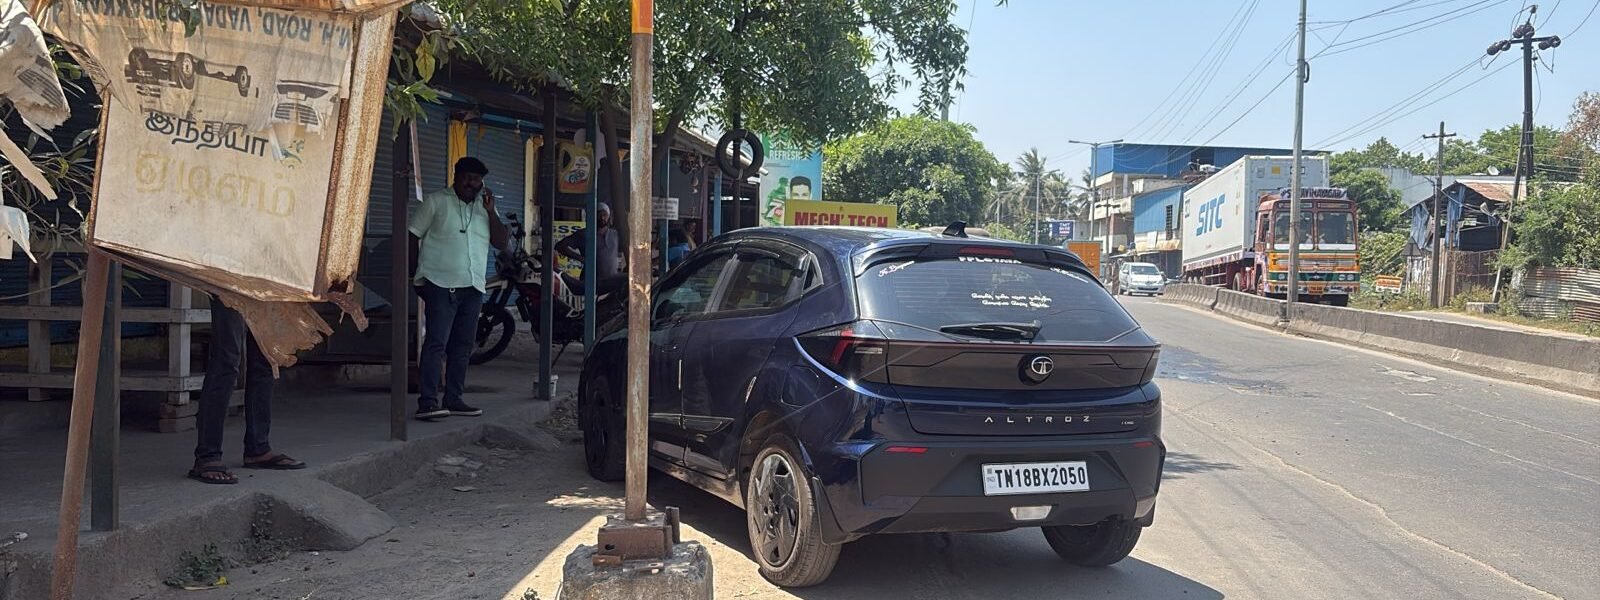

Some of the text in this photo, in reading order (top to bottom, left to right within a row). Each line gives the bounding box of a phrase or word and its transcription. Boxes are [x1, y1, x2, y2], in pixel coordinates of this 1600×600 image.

[257, 7, 312, 43] ROAD,
[1196, 193, 1226, 237] SITC
[984, 415, 1091, 424] ALTROZ
[994, 466, 1087, 489] TN18BX2050
